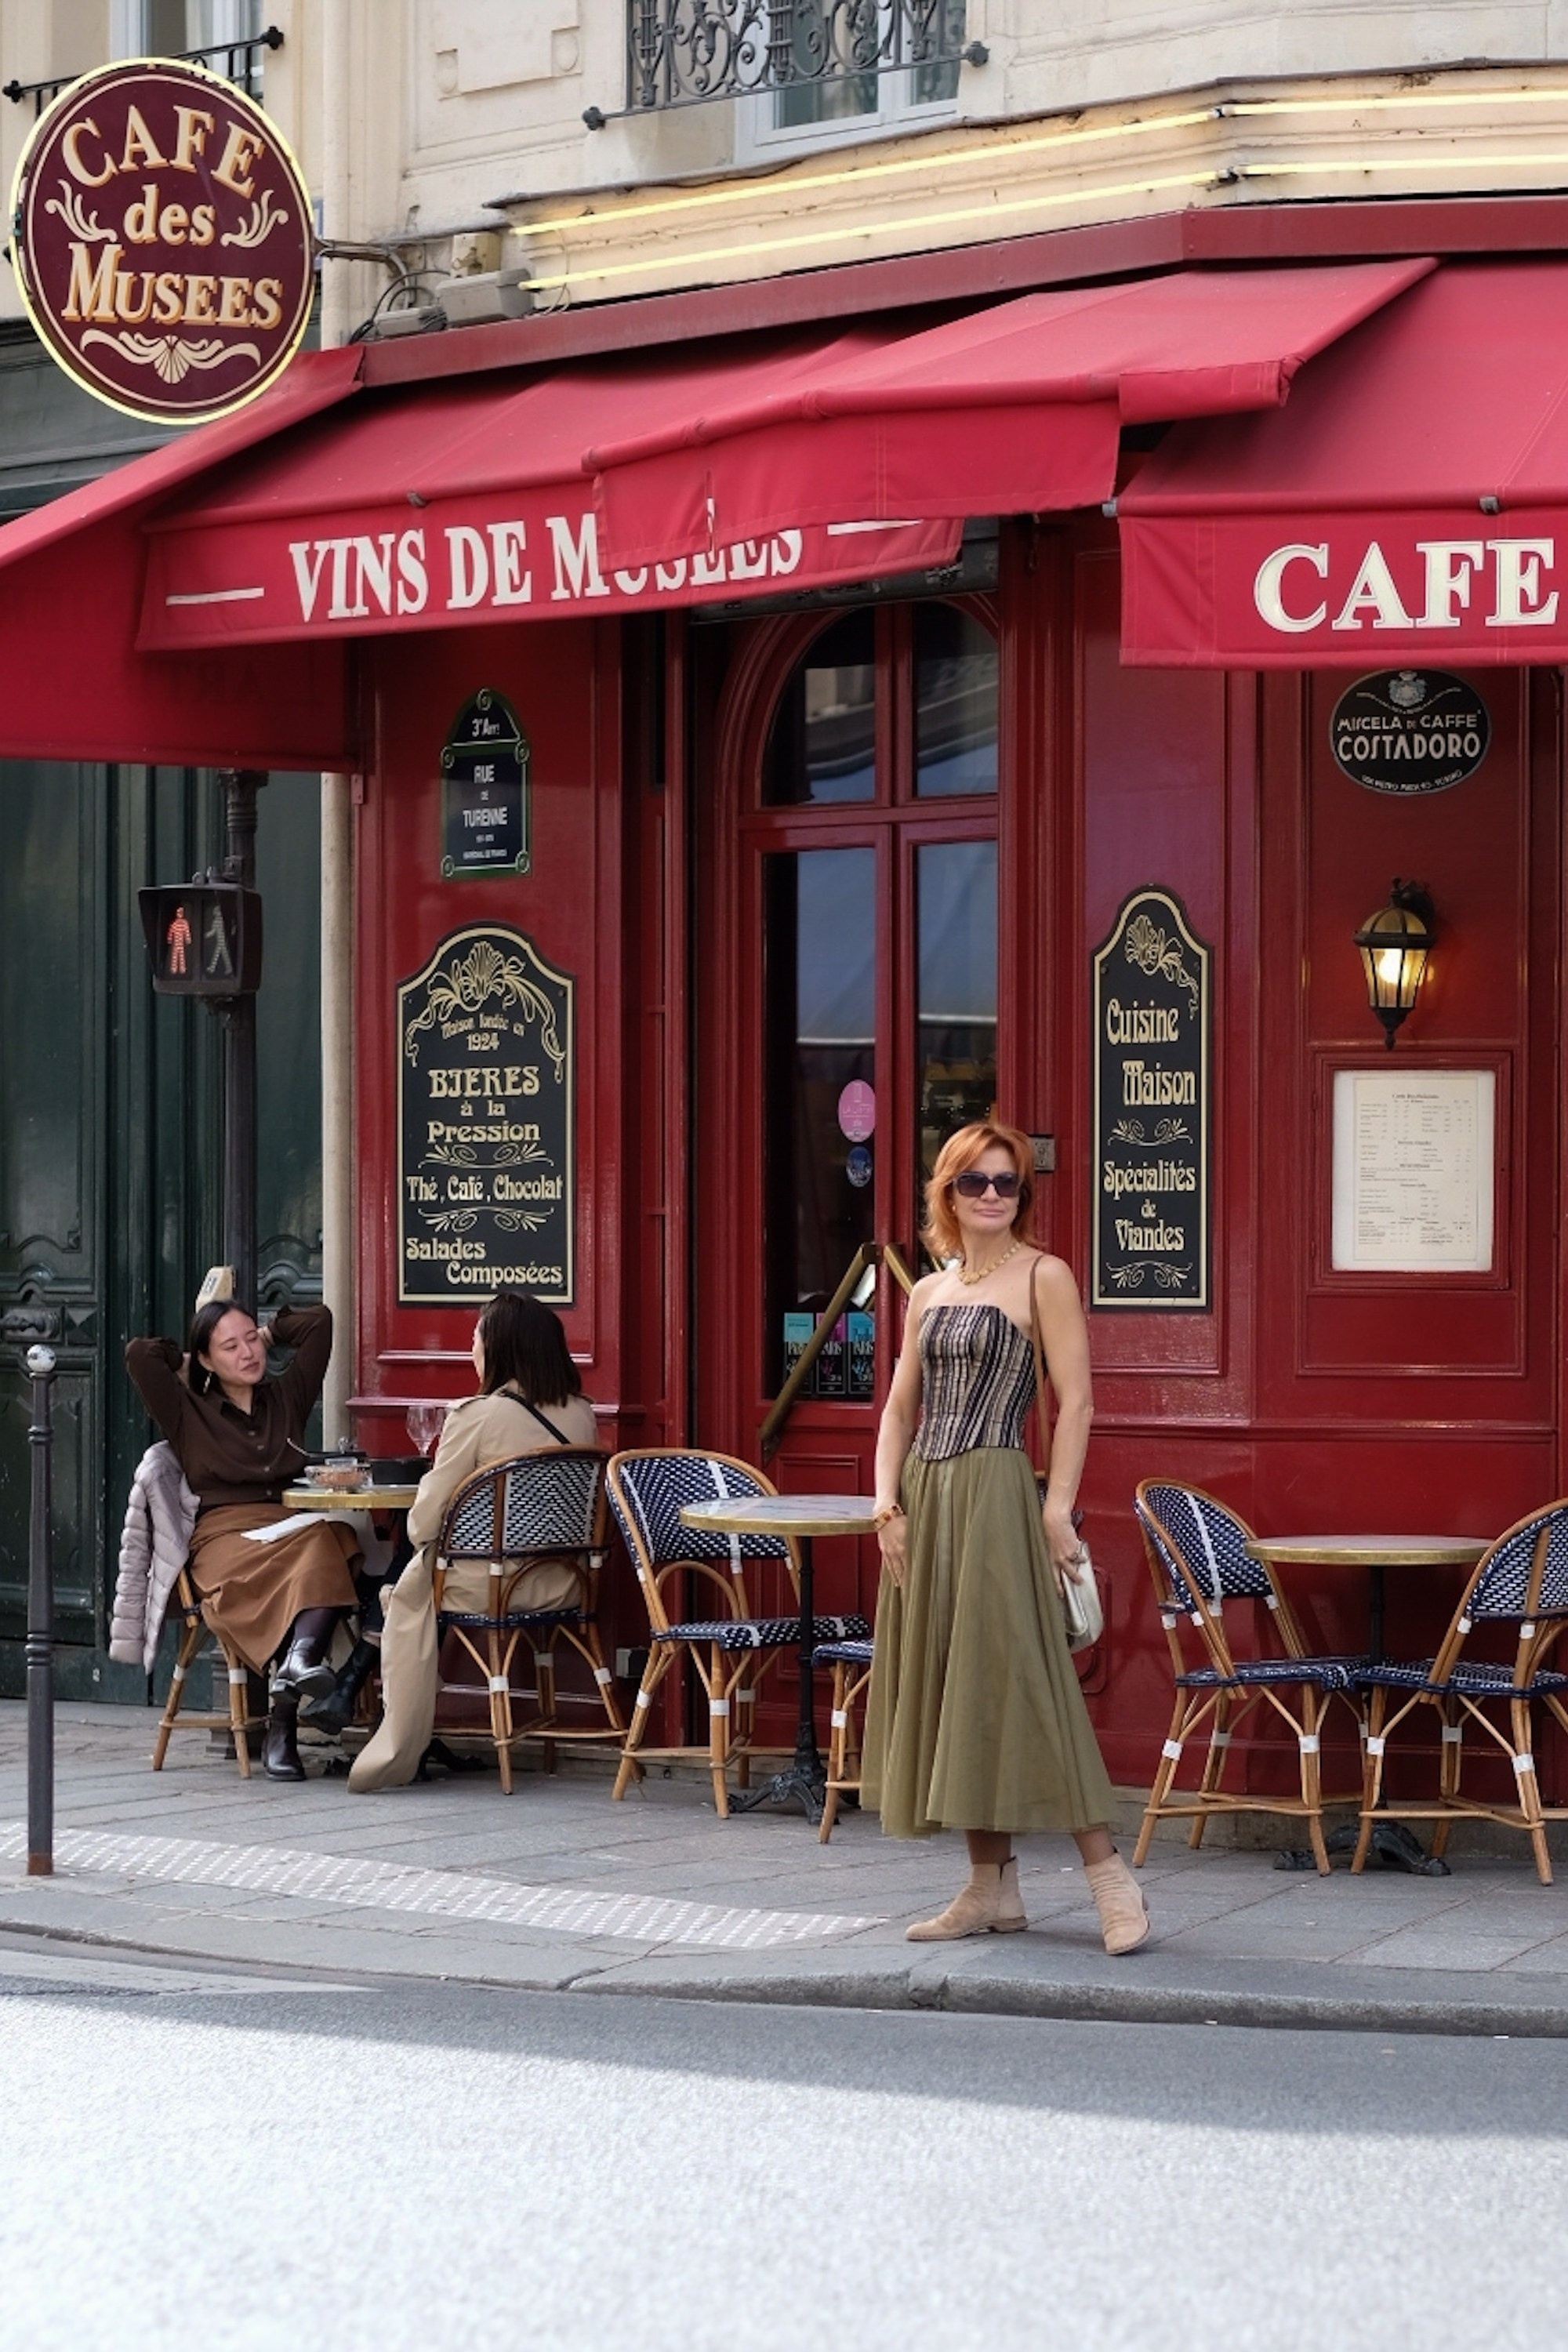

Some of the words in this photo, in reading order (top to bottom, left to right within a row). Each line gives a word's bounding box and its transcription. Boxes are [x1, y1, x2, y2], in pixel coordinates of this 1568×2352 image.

[62, 104, 264, 199] CAFE
[123, 183, 216, 245] des
[61, 242, 283, 329] MUSEES
[289, 528, 429, 622] VINS
[444, 521, 532, 610] DE
[1254, 538, 1560, 633] CAFE
[1338, 732, 1481, 761] COSTADORO
[474, 764, 495, 783] RUE
[463, 807, 508, 828] TURENNE
[1106, 998, 1180, 1045] Cuisine
[466, 1032, 500, 1051] 1924
[1122, 1060, 1196, 1106] Maison
[487, 1099, 506, 1116] la
[426, 1120, 541, 1144] Pression
[492, 1174, 564, 1202] Chocolat
[1103, 1159, 1196, 1200] Spécialités
[406, 1237, 487, 1261] Salades
[1114, 1218, 1185, 1250] Viandes
[446, 1260, 564, 1290] Composées
